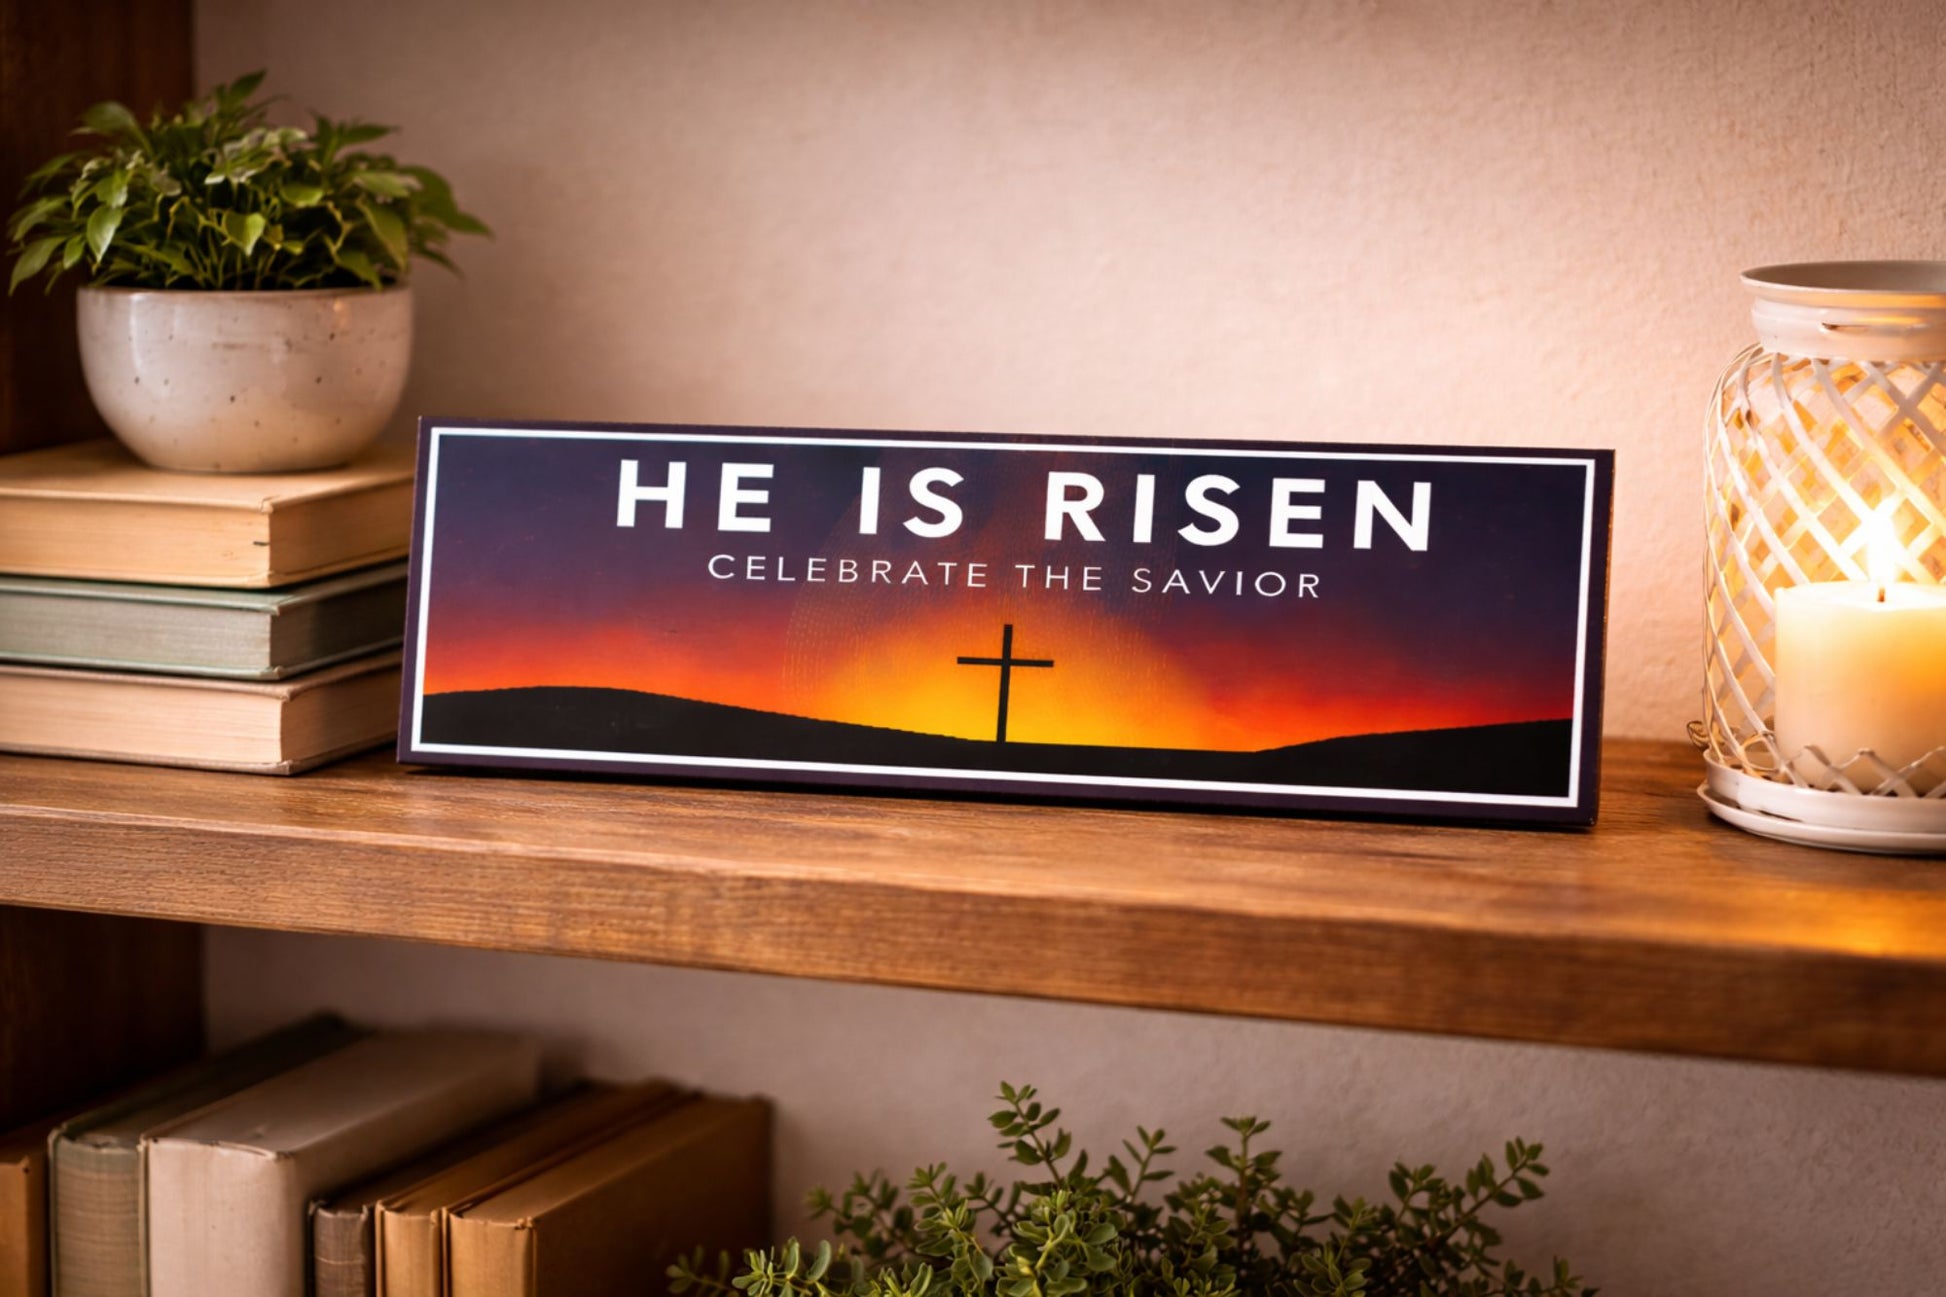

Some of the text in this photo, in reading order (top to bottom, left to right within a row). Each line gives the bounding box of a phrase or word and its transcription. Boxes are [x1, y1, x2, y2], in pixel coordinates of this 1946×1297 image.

[616, 458, 1432, 552] HE IS RISEN
[707, 553, 1321, 599] CELEBRATE THE SAVIOR
